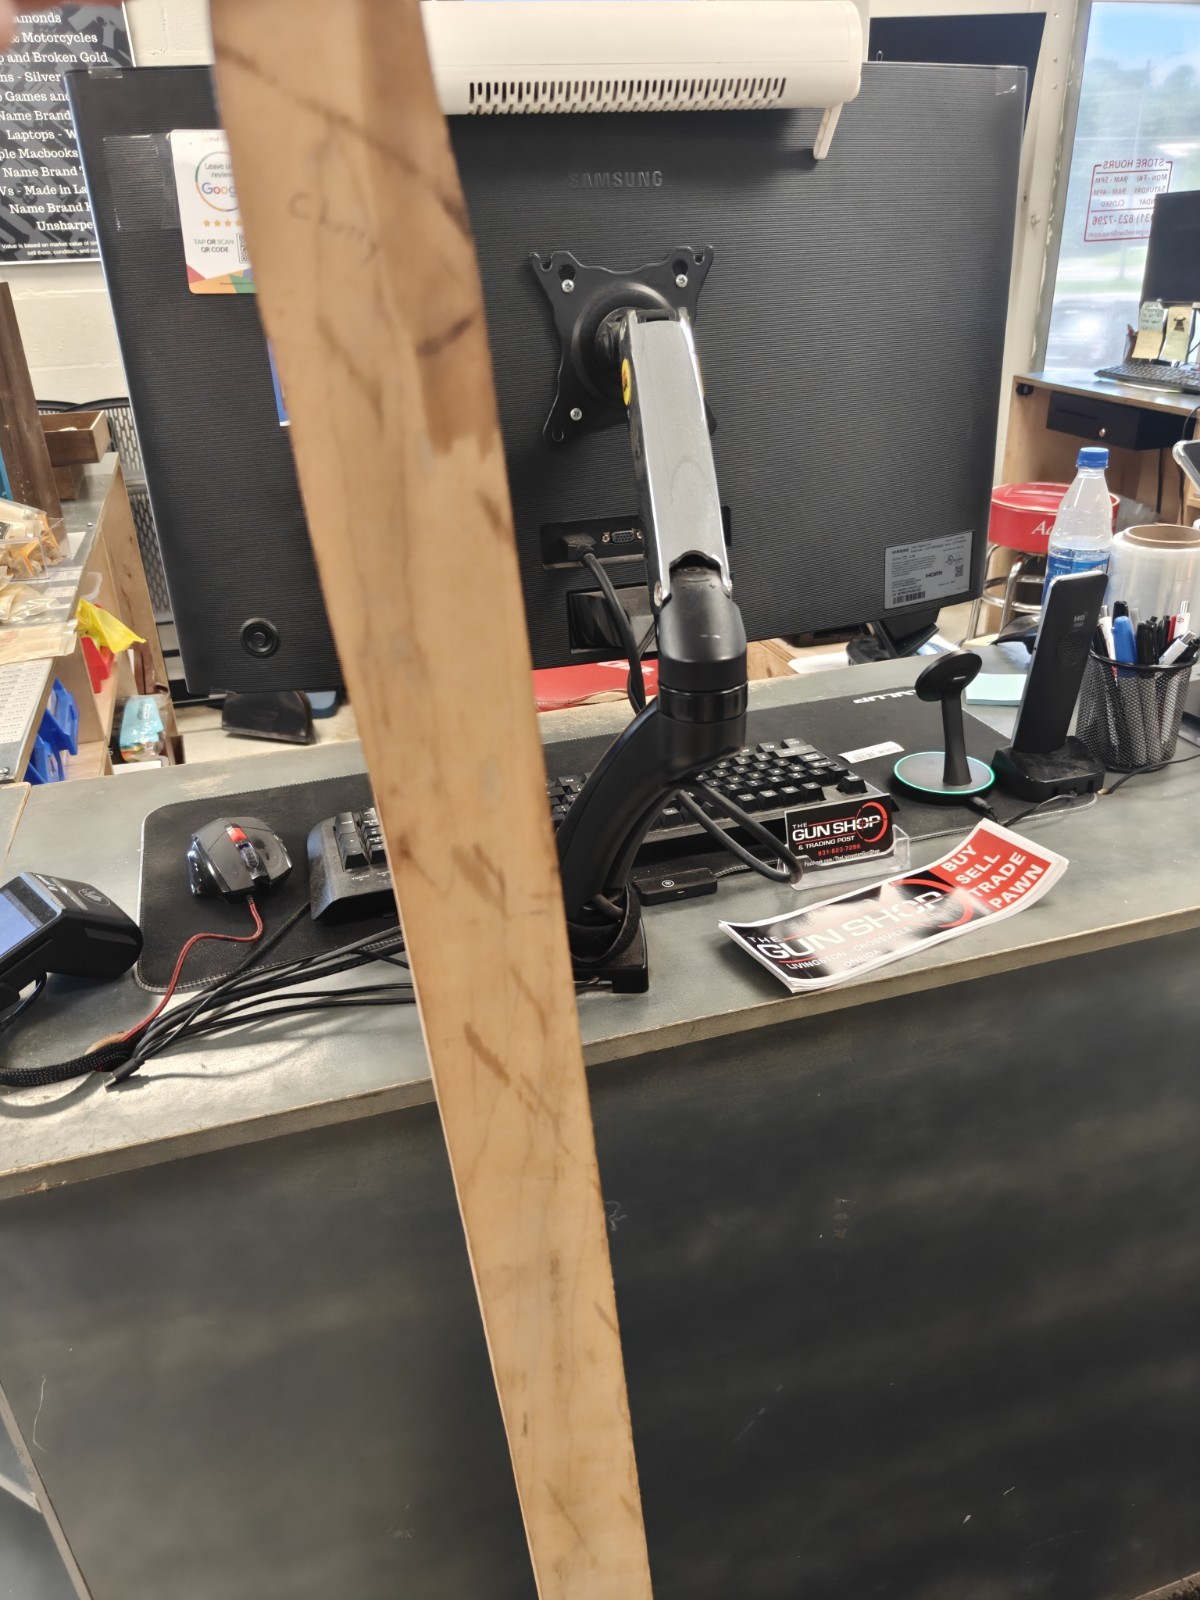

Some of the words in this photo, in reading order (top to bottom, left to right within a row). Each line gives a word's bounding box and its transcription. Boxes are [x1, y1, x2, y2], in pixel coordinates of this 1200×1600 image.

[14, 12, 62, 24] amonds
[21, 32, 99, 46] Motorcycles
[6, 52, 31, 63] and
[32, 51, 78, 63] Broken
[79, 51, 109, 63] Gold
[0, 73, 15, 82] ns
[24, 71, 61, 82] Silver
[5, 91, 47, 102] Games
[0, 111, 32, 121] Name
[33, 110, 71, 121] Brand
[6, 129, 55, 142] Laptops
[0, 148, 16, 160] ple
[17, 147, 79, 159] Macbooks
[2, 167, 39, 178] Name
[39, 166, 78, 177] Brand
[205, 162, 224, 170] Leave
[568, 170, 663, 188] SAMSUNG
[0, 186, 15, 196] Vs
[24, 185, 57, 195] Made
[59, 184, 72, 195] in
[72, 184, 88, 195] La
[9, 203, 45, 215] Name
[46, 202, 83, 213] Brand
[36, 220, 94, 232] Unsharpe
[792, 822, 808, 830] THE
[792, 824, 831, 842] GUN
[832, 815, 881, 834] SHOP
[805, 839, 836, 850] TRADING
[836, 835, 855, 844] POST
[940, 844, 977, 873] BUY
[955, 852, 1001, 885] SELL
[969, 851, 1026, 898] TRADE
[987, 863, 1044, 909] PAWN
[756, 928, 846, 960] GUN
[841, 891, 944, 937] SHOP
[747, 935, 780, 944] THE
[785, 951, 848, 970] LIVINGSTON
[852, 926, 913, 952] CROSSVILLE
[842, 948, 883, 968] ONEIDA
